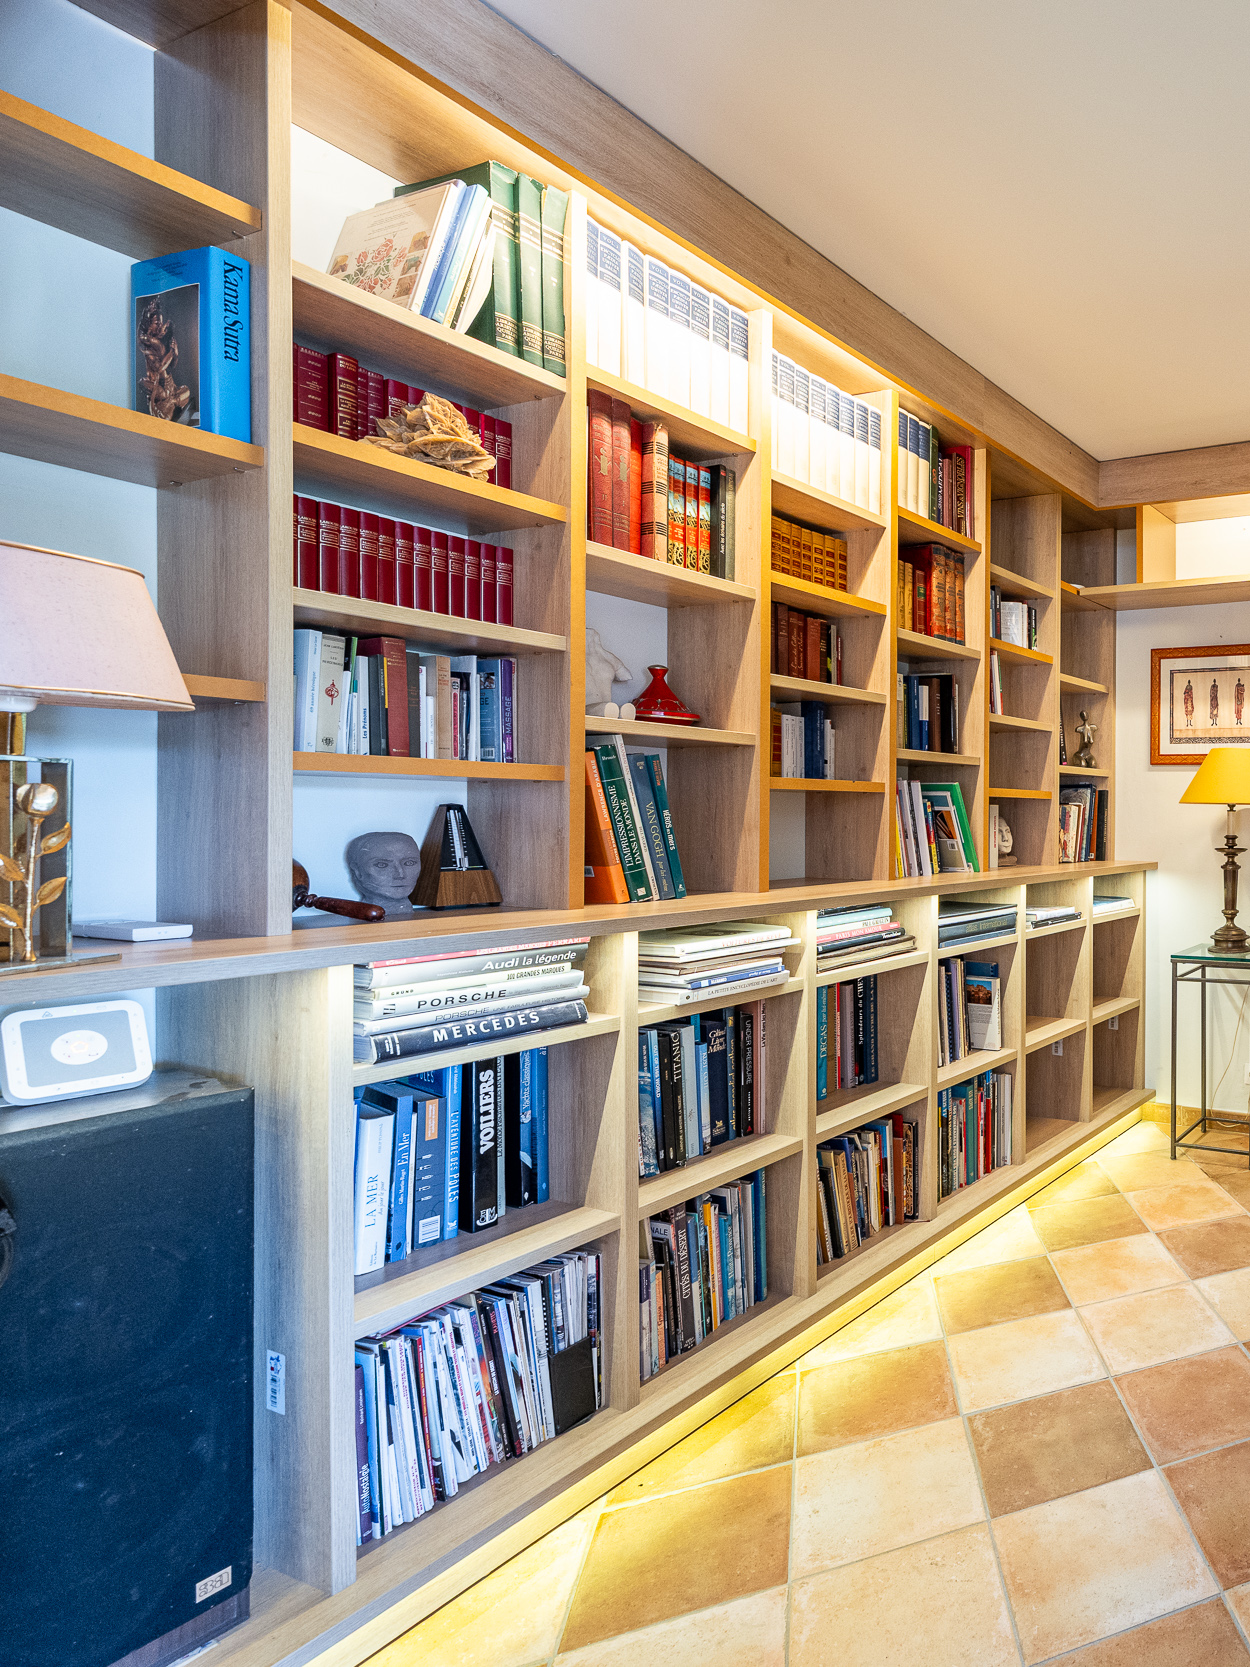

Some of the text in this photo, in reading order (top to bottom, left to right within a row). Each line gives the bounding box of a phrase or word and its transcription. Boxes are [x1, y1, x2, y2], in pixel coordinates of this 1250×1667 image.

[224, 260, 244, 362] Kama Sutra
[598, 788, 609, 822] LAWRENCE
[645, 802, 658, 824] VAN
[608, 785, 634, 867] L'IMPRESSIONNISME
[620, 798, 642, 864] DANS LE MONDE
[650, 825, 665, 858] GOGH
[865, 926, 882, 934] AMOUR
[481, 950, 577, 971] Audi la légende
[516, 965, 565, 979] GRANDES MARQUES
[417, 989, 507, 1009] PORSCHE
[730, 981, 760, 991] ENCYCLOPÉDIE
[433, 1012, 541, 1043] MERCEDES
[434, 1007, 490, 1022] PORSCHE
[671, 1032, 682, 1082] TITANIC
[522, 1051, 531, 1109] Yachts classiques
[479, 1069, 495, 1154] VOILIERS
[398, 1132, 410, 1166] En Mer
[448, 1110, 459, 1202] L'AVENTURE DES PÔLES
[364, 1173, 378, 1228] LA MER
[677, 1229, 691, 1299] CITÉS DU DÉSERT
[359, 1463, 371, 1514] AutoNostalgie
